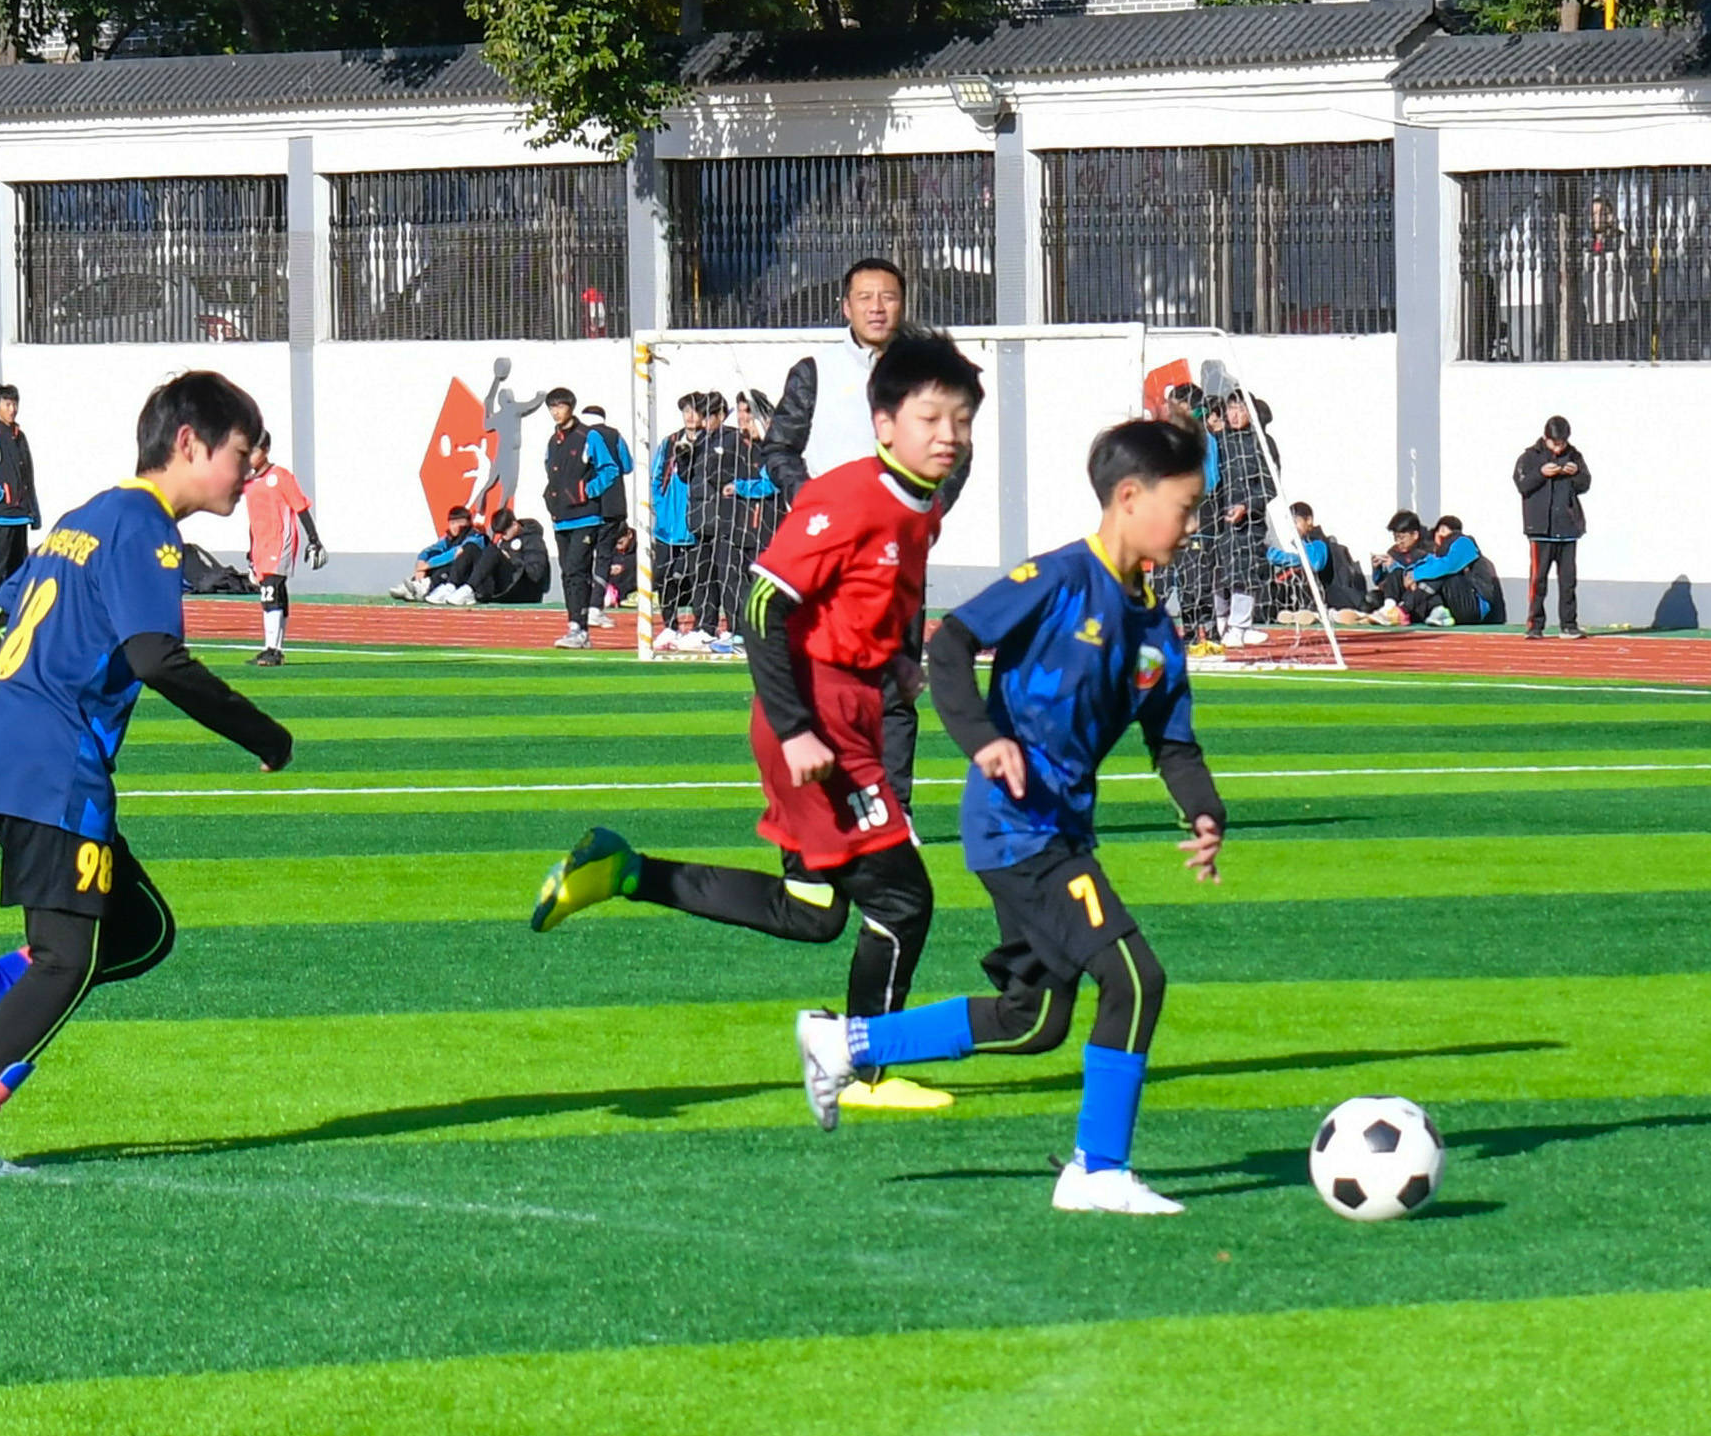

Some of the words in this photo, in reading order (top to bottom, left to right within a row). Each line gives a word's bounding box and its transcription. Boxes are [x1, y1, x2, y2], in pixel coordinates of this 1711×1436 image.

[847, 783, 889, 832] 15
[76, 840, 113, 895] 98
[1067, 872, 1104, 929] 7
